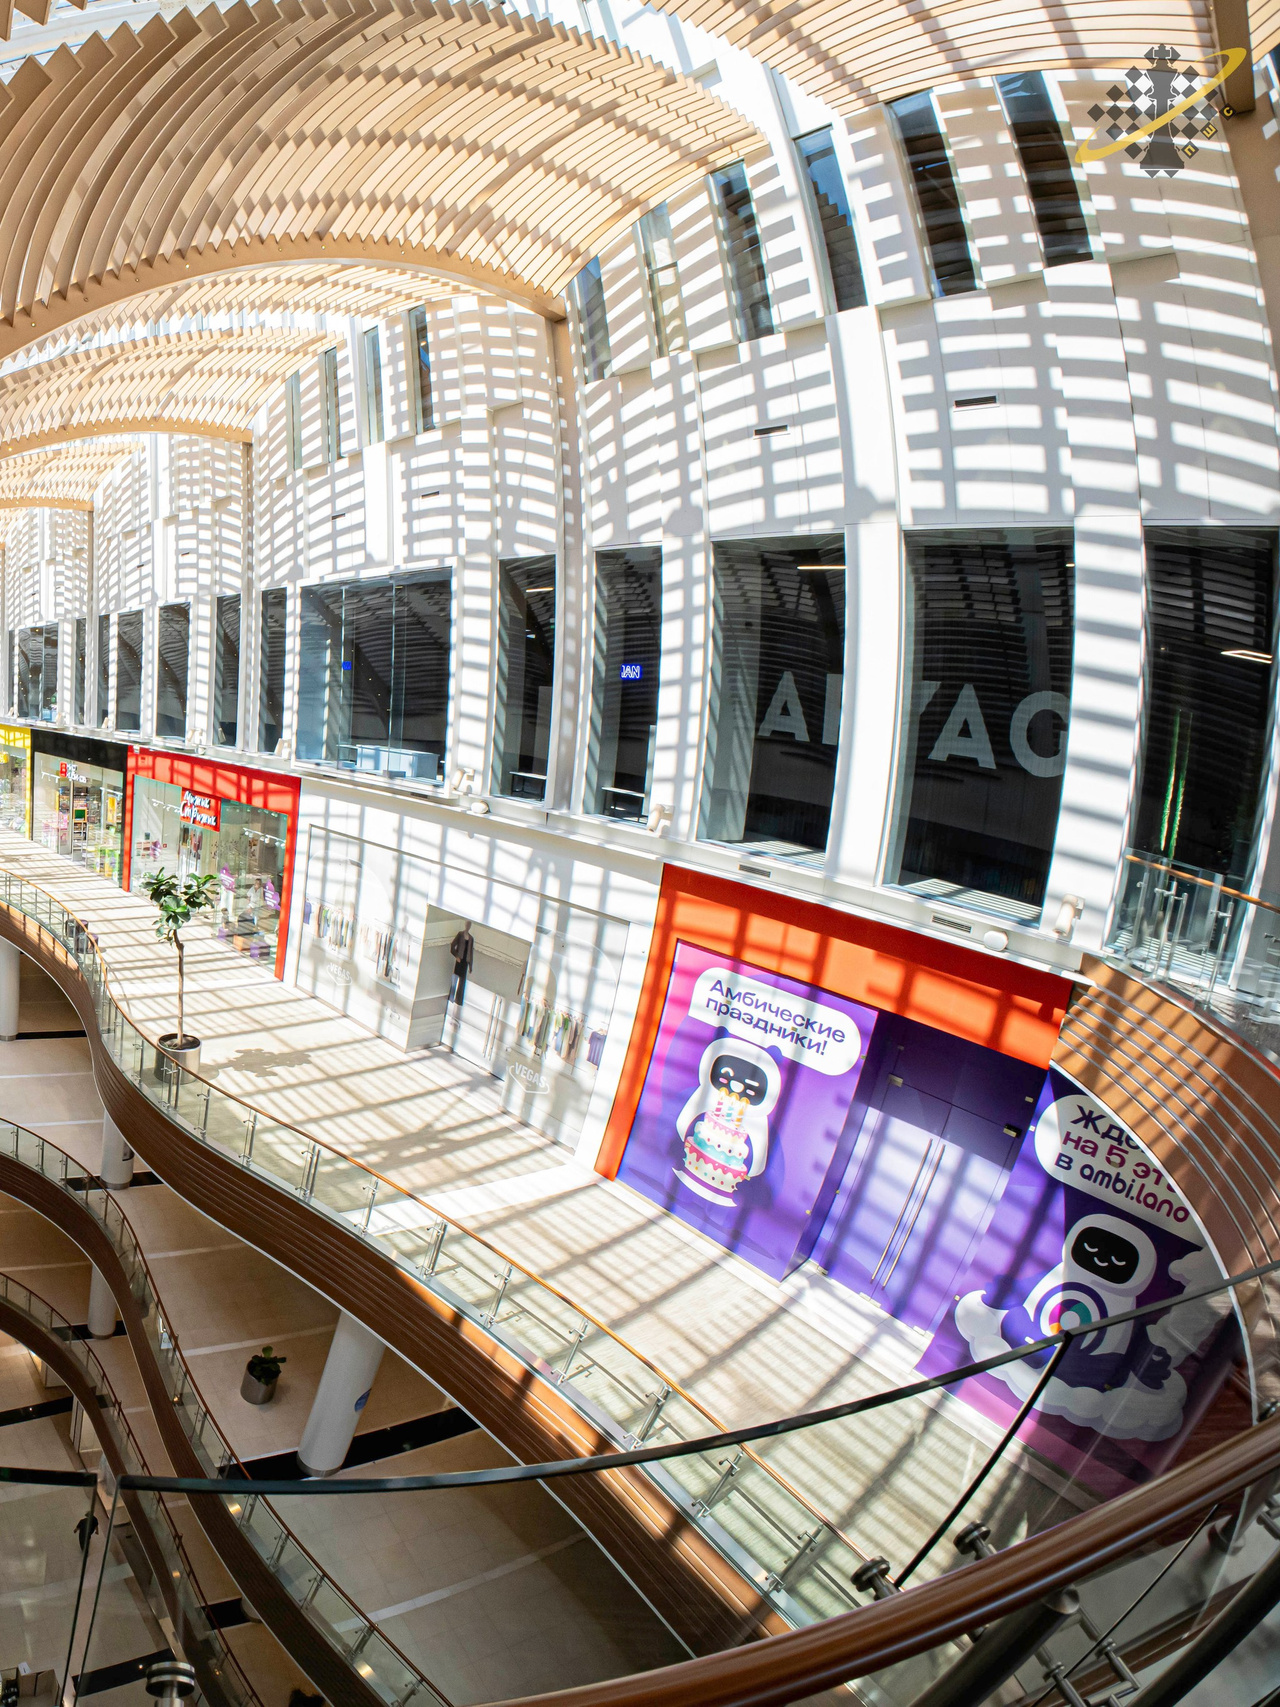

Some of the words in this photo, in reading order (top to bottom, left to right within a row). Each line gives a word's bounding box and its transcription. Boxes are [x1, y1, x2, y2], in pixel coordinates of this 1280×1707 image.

[329, 962, 351, 981] VEGAS
[705, 997, 828, 1056] праздники!
[709, 979, 846, 1043] Амбические
[515, 1061, 546, 1088] VEGAS
[1062, 1131, 1099, 1158] на
[1105, 1144, 1129, 1168] 5
[1132, 1162, 1176, 1193] эт
